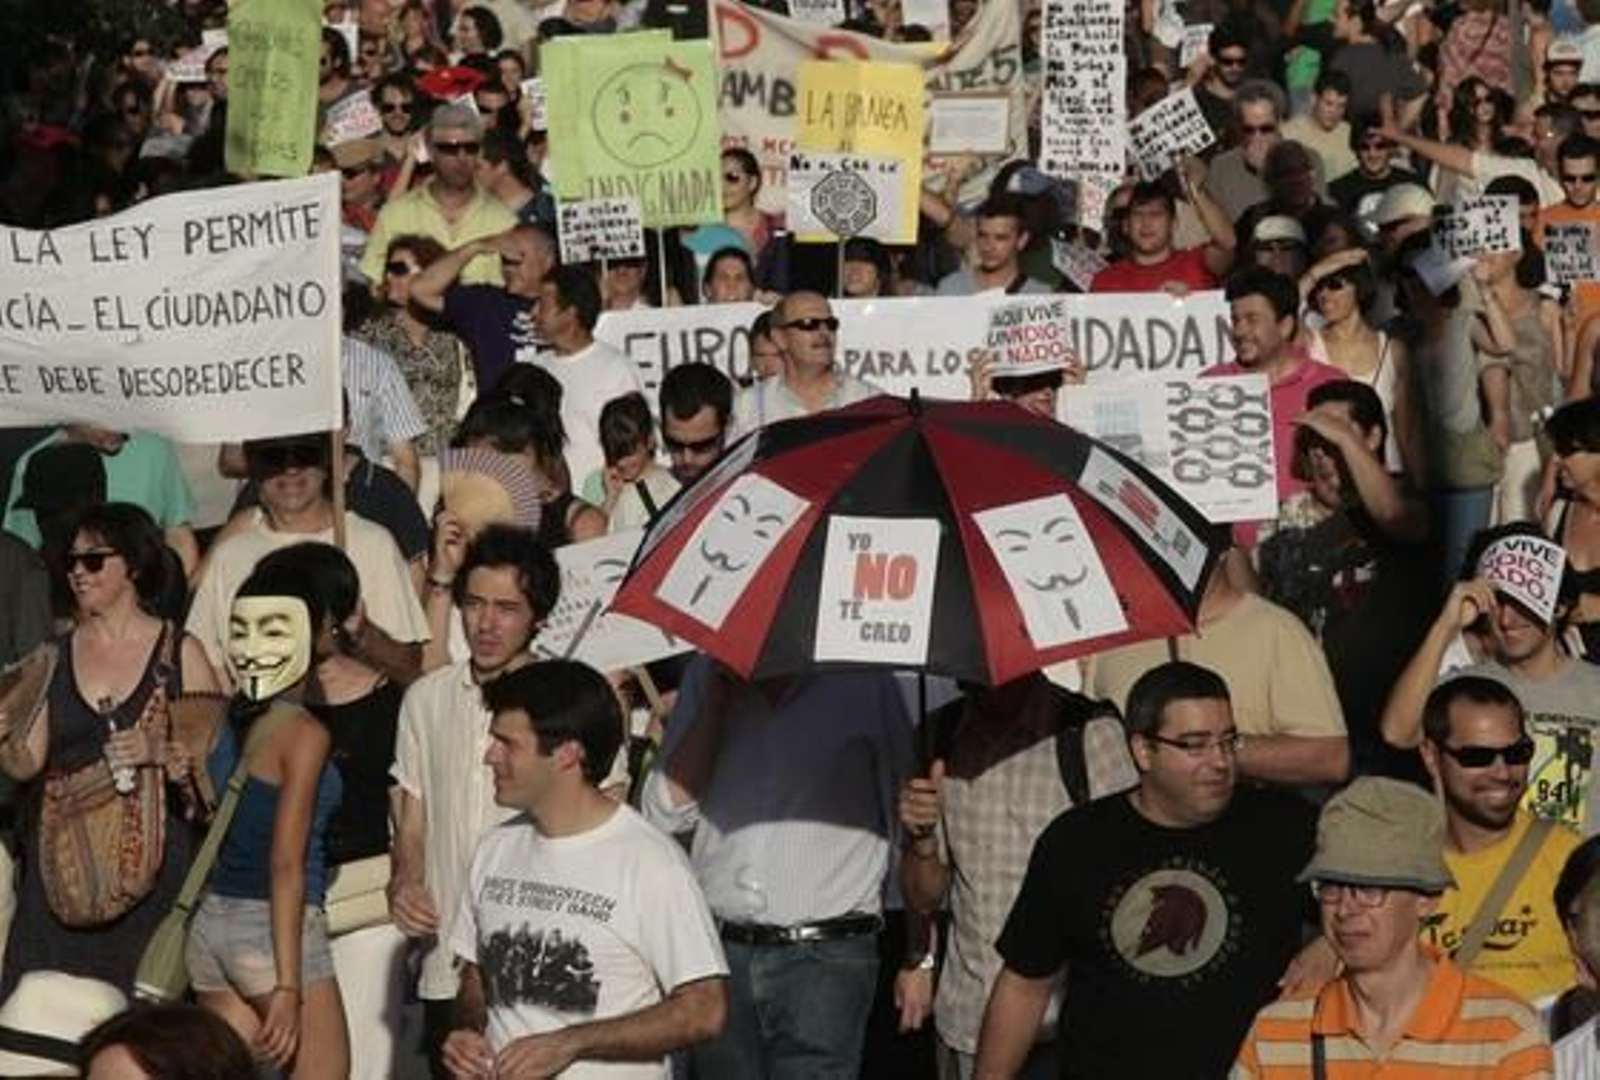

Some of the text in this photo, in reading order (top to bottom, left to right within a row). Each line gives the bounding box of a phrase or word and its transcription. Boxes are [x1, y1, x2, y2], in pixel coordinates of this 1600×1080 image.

[10, 202, 320, 265] LA LEY PERMITE
[0, 281, 326, 331] CIA EL CIUDADANO
[0, 353, 306, 398] E DEBE DESOBEDECER
[625, 326, 754, 388] EURO
[840, 349, 914, 377] PARA
[847, 532, 872, 551] YO
[853, 552, 918, 601] NO
[1487, 566, 1549, 606] ADO.
[839, 600, 863, 620] TE
[860, 621, 912, 643] CREO
